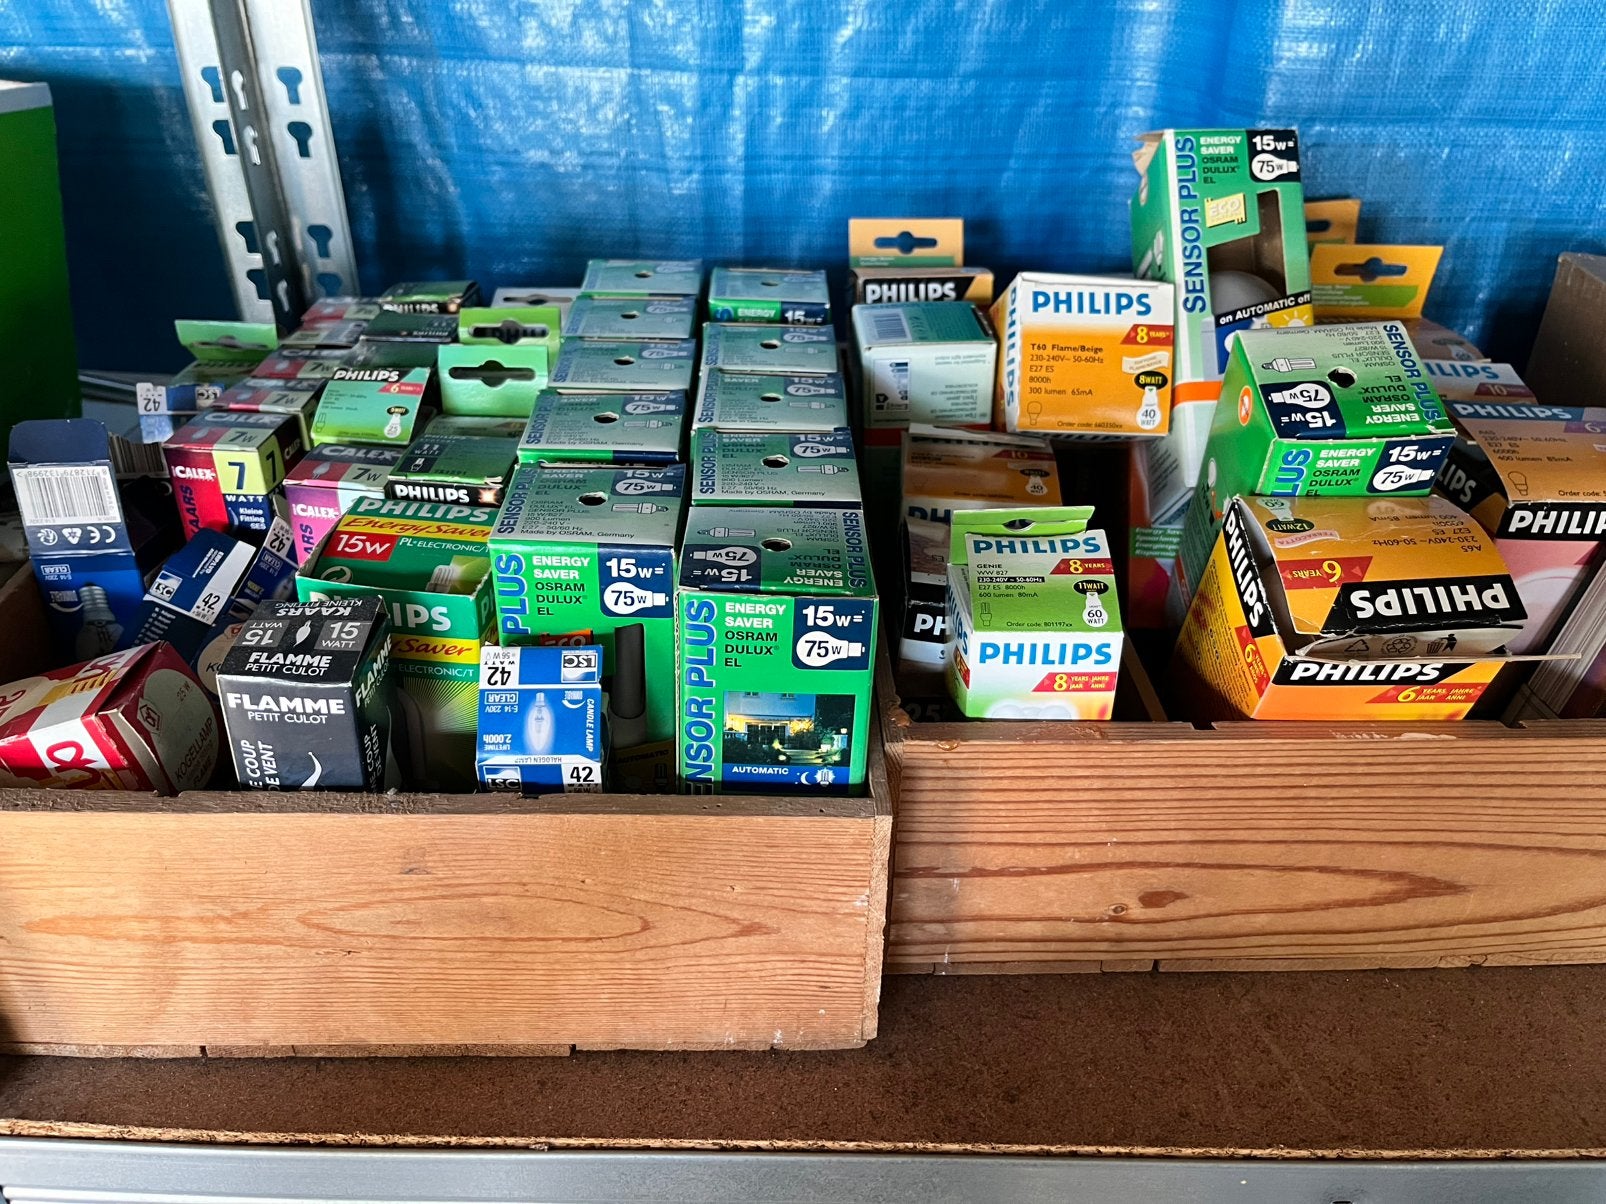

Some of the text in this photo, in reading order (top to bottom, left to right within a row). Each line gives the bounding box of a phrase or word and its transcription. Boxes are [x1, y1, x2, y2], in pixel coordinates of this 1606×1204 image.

[1200, 136, 1242, 145] ENERGY
[1200, 146, 1234, 154] SAVER
[1202, 156, 1239, 164] OSRAM
[1203, 165, 1236, 174] DULUX
[1175, 135, 1207, 314] SENSOR PLUS
[865, 281, 957, 304] PHILIPS
[383, 303, 439, 314] PHILIPS
[1032, 290, 1152, 316] PHILIPS
[1219, 315, 1233, 325] on
[1235, 298, 1296, 320] AUTOMATIC
[1297, 293, 1312, 304] off
[737, 308, 776, 318] ENERGY
[1136, 326, 1148, 343] 8
[1006, 287, 1017, 407] PHILIPS
[1030, 343, 1104, 354] T60 Flame/Beige
[1072, 355, 1104, 363] 50-60Hz
[334, 369, 400, 382] PHILIPS
[1045, 365, 1054, 373] ES
[1383, 324, 1441, 423] SENSOR PLUS
[1044, 387, 1093, 396] lumen 65mA
[1362, 385, 1406, 393] DULUX
[1362, 393, 1411, 403] OSRAM
[143, 398, 161, 412] 42
[1371, 403, 1416, 412] SAVER
[1453, 403, 1573, 420] PHILIPS
[1142, 408, 1156, 418] 40
[1365, 413, 1420, 424] ENERGY
[1585, 422, 1601, 433] 6
[321, 445, 394, 462] CALEX
[1320, 448, 1376, 458] ENERGY
[1316, 459, 1360, 467] SAVER
[175, 465, 212, 481] CALEX
[227, 461, 246, 491] 7
[699, 456, 717, 494] SENSOR
[1312, 468, 1360, 477] OSRAM
[225, 494, 264, 503] WATT
[394, 484, 470, 503] PHILIPS
[239, 507, 264, 515] Kleine
[295, 503, 338, 519] CALEX
[357, 498, 490, 522] PHILIPS
[497, 492, 527, 534] SENSOR
[239, 515, 265, 524] Fitting
[344, 516, 430, 535] Energy
[269, 533, 286, 553] 42
[1278, 531, 1337, 546] TERRACOTTA
[842, 511, 868, 589] SENSOR PLUS
[972, 536, 1101, 555] PHILIPS
[1461, 544, 1482, 552] A65
[532, 555, 591, 567] ENERGY
[1069, 559, 1083, 573] 8
[533, 569, 580, 579] SAVER
[796, 568, 843, 577] SAVER
[1225, 510, 1264, 628] PHILIPS
[1292, 560, 1343, 583] 6 YEARS
[535, 581, 585, 592] OSRAM
[783, 576, 844, 587] ENERGY
[154, 582, 174, 598] LSC
[495, 553, 531, 635] PLUS
[202, 592, 221, 610] 42
[319, 599, 363, 607] KLEINE
[536, 594, 583, 604] DULUX
[1350, 583, 1511, 619] PHILIPS
[276, 606, 352, 617] KAARS
[537, 606, 554, 616] EL
[725, 602, 786, 615] ENERGY
[1087, 609, 1103, 618] 60
[724, 617, 773, 628] SAVER
[329, 621, 361, 639] 15
[724, 631, 778, 642] OSRAM
[241, 629, 275, 646] 15
[321, 640, 356, 648] WATT
[685, 599, 717, 688] PLUS
[399, 638, 473, 656] Saver
[724, 644, 774, 655] DULUX
[978, 642, 1112, 665] PHILIPS
[248, 651, 333, 668] FLAMME
[564, 655, 596, 668] LSC
[724, 657, 742, 667] EL
[244, 663, 328, 676] PETIT CULOT
[355, 633, 392, 708] FLAMME
[398, 663, 475, 677] ELECTRONIC/T
[487, 666, 511, 686] 42
[1290, 662, 1445, 681] PHILIPS
[1053, 674, 1068, 691] 8
[487, 693, 517, 703] CLEAR
[1397, 686, 1420, 703] 6
[226, 692, 346, 715] FLAMME
[485, 705, 502, 713] 230V
[247, 711, 328, 724] PETIT CULOT
[585, 698, 595, 752] CANDLE LAMP
[483, 734, 512, 743] 2.000h
[174, 716, 213, 784] KOGELLAMP
[240, 739, 261, 778] COUP
[257, 740, 278, 775] VENT
[570, 766, 595, 783] 42
[731, 766, 789, 775] AUTOMATIC
[487, 778, 518, 790] LSC
